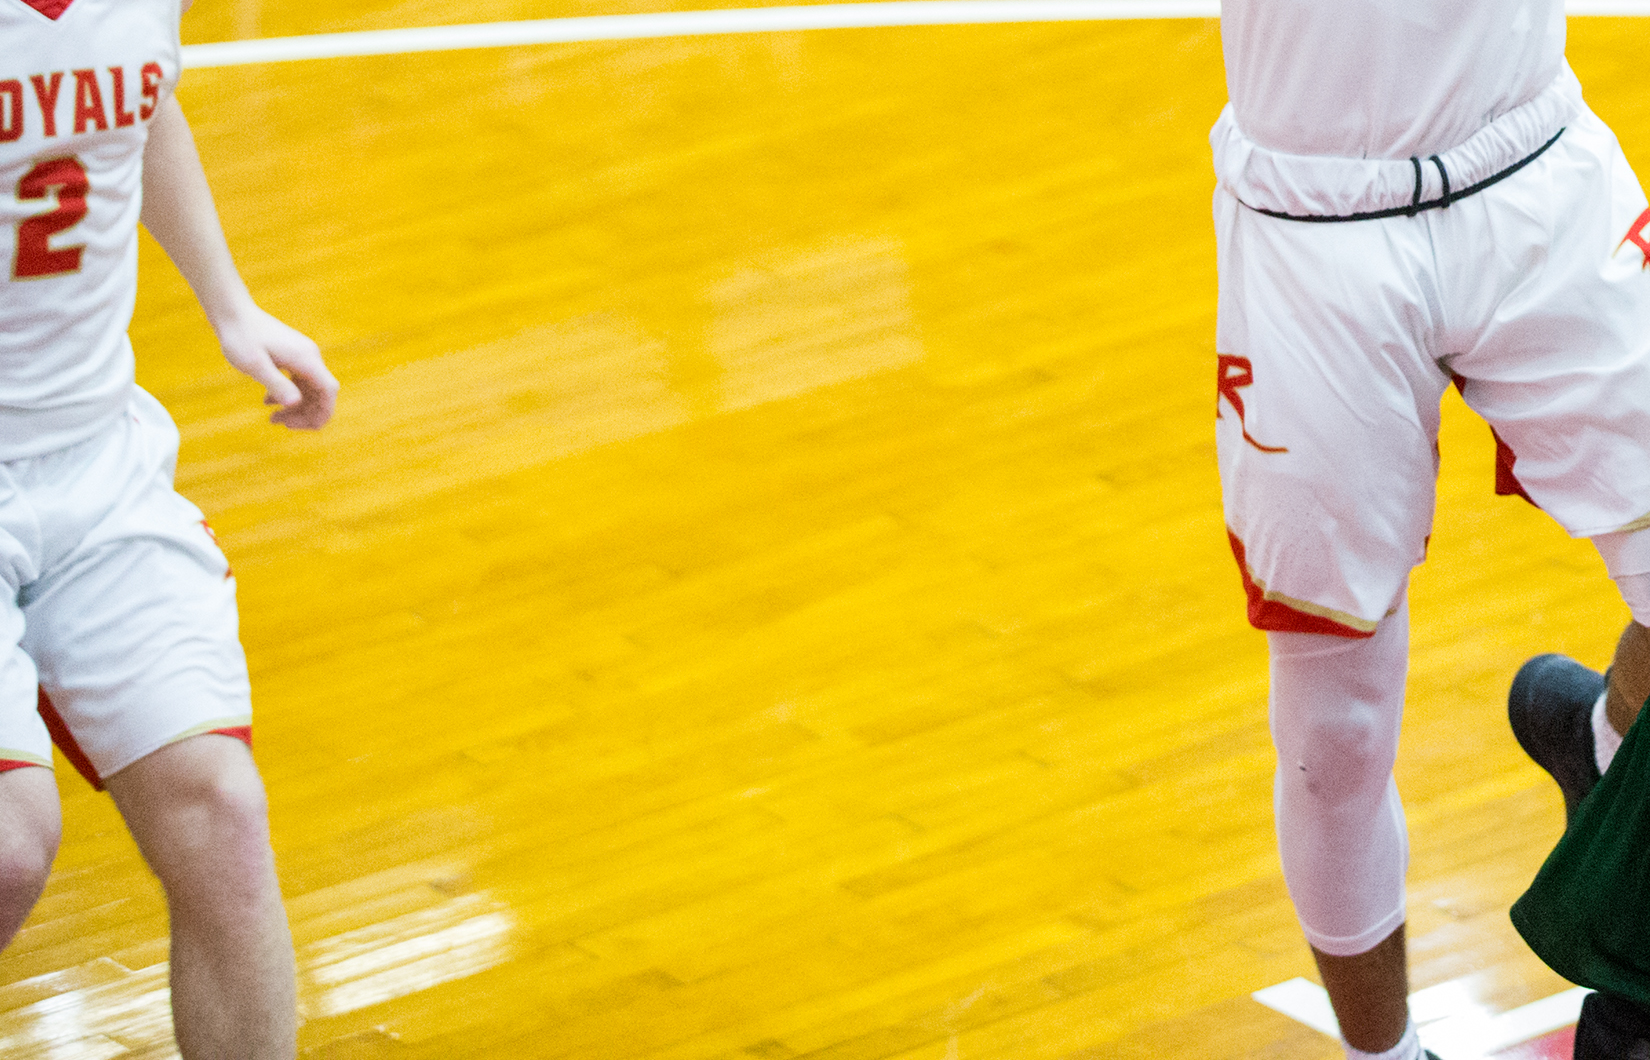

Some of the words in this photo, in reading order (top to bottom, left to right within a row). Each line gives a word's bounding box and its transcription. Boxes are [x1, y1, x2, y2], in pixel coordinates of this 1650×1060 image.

[0, 60, 164, 146] OYALS
[10, 154, 90, 282] 2
[1216, 353, 1289, 453] R
